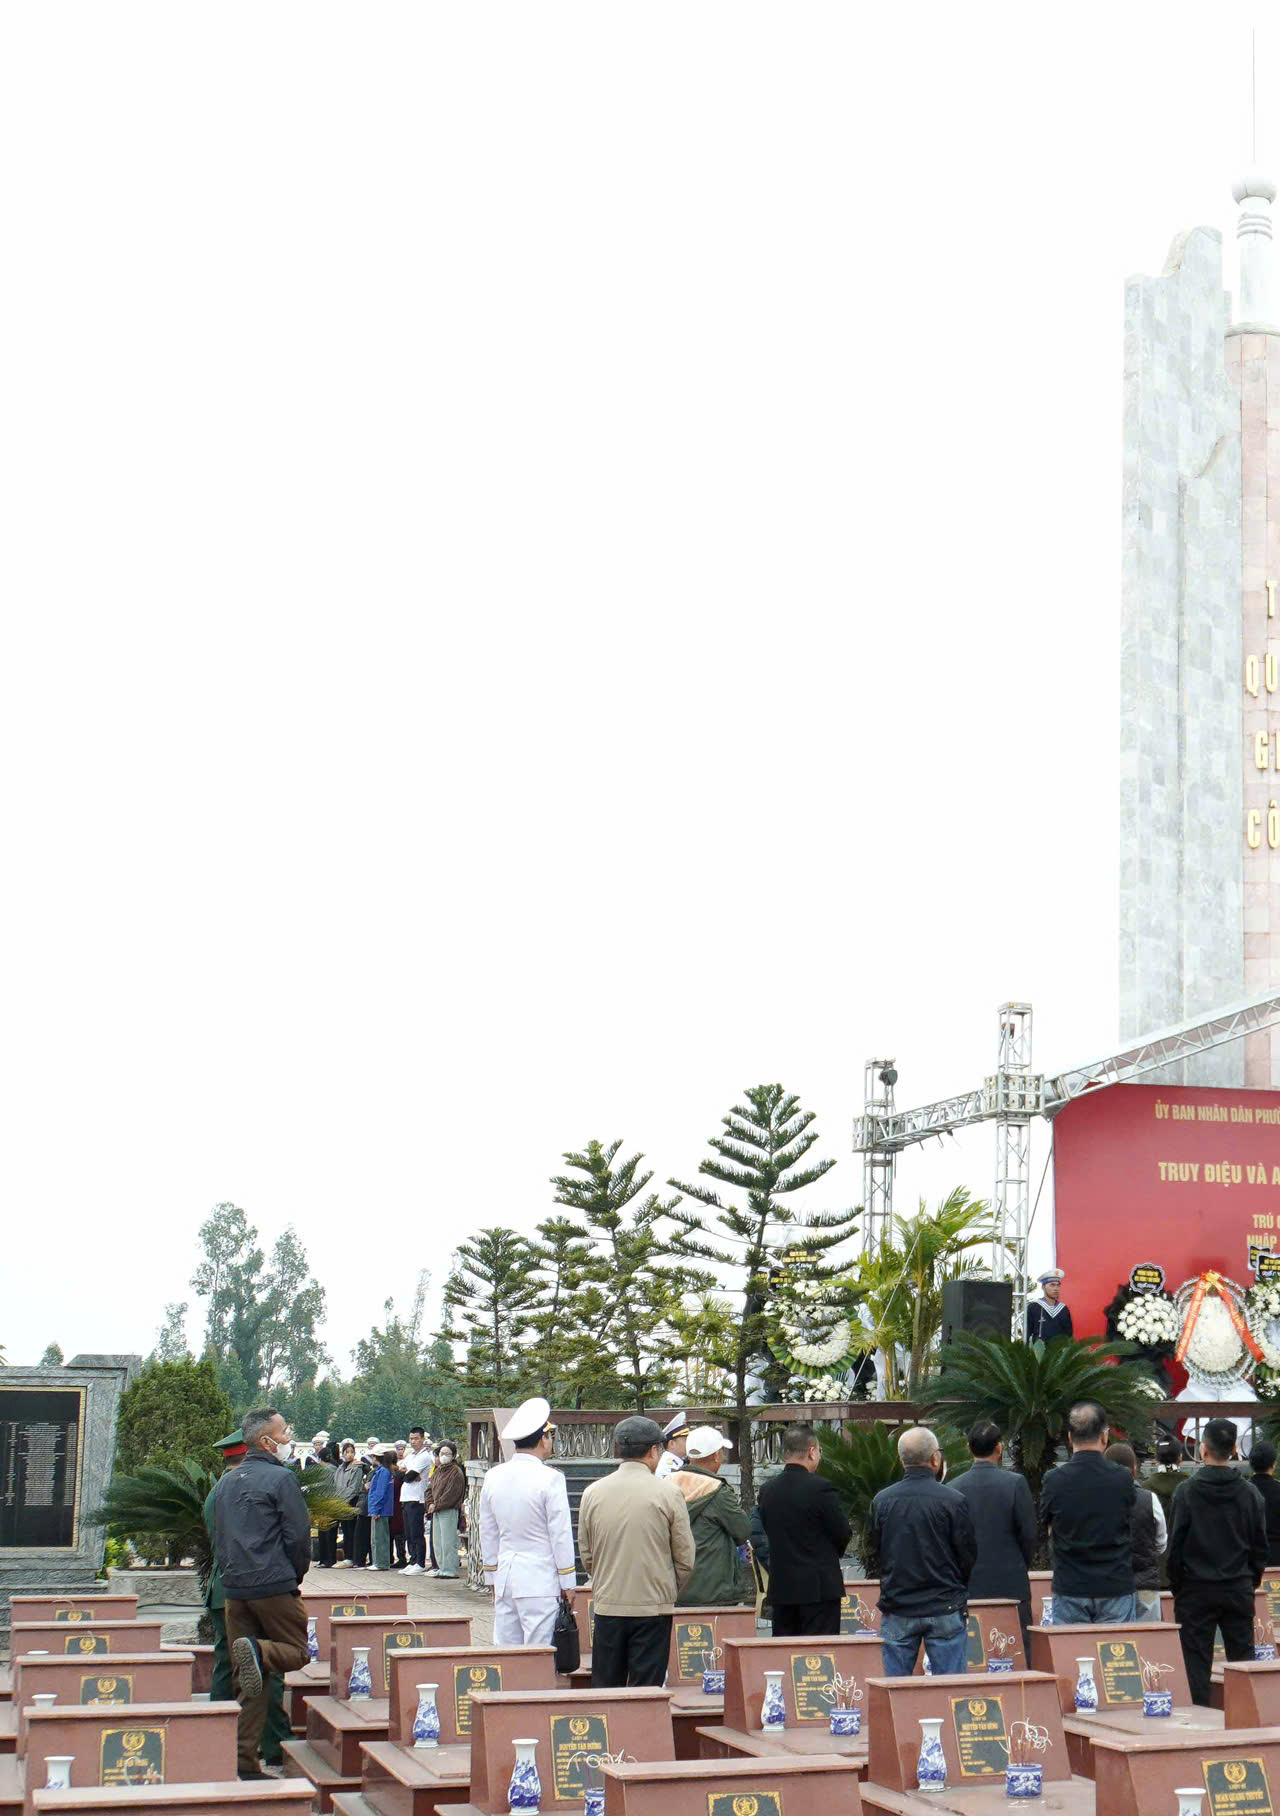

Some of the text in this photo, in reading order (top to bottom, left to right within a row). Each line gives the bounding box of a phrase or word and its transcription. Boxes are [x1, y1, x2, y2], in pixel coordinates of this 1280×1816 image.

[1155, 1099, 1169, 1119] ỦY
[1172, 1104, 1195, 1121] BAN
[1198, 1104, 1228, 1122] NHÂN
[1231, 1105, 1253, 1123] DÂN
[1158, 1162, 1200, 1182] TRUY
[1204, 1161, 1242, 1188] ĐIỆU
[1246, 1162, 1268, 1185] VÀ
[1253, 1212, 1274, 1229] TRÚ
